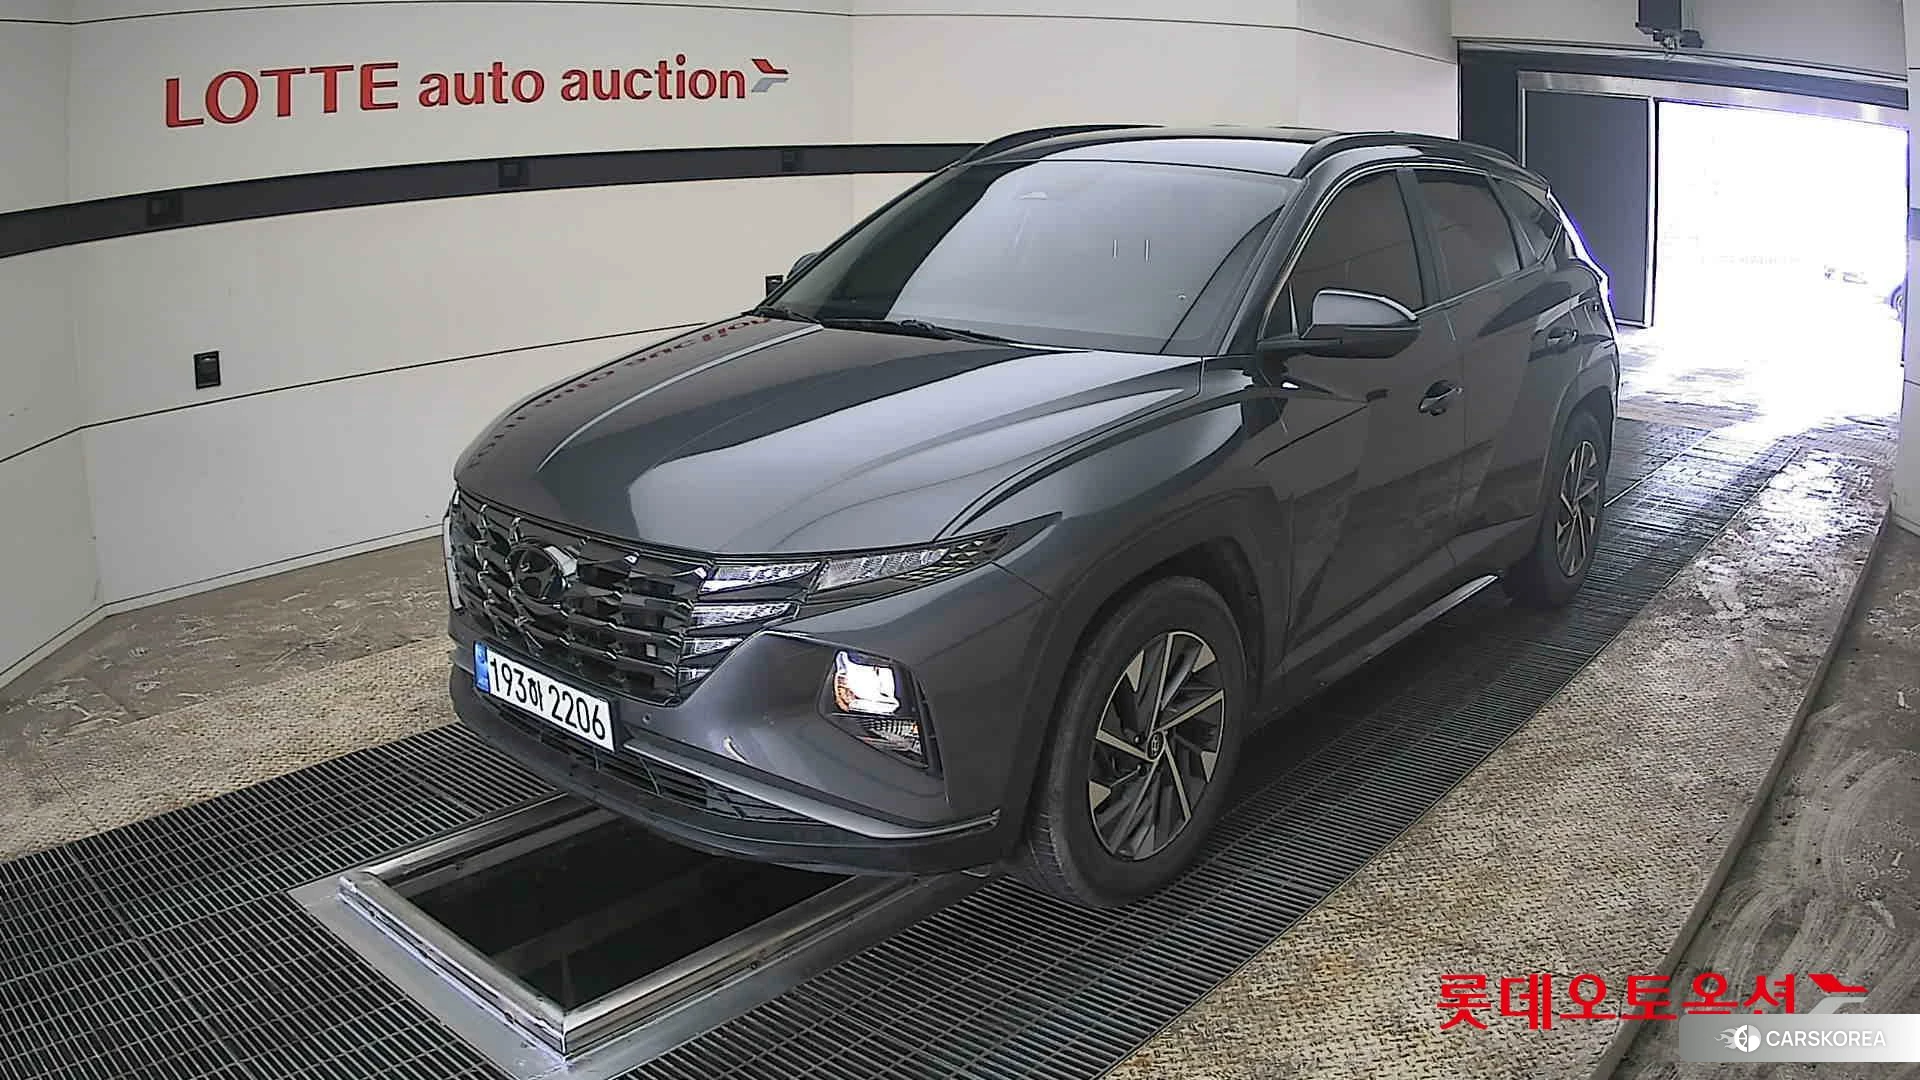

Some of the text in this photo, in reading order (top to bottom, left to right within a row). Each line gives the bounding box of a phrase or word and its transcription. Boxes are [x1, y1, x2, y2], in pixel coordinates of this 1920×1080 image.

[165, 53, 746, 128] LOTTE auto auction
[490, 657, 606, 741] 193하 2206
